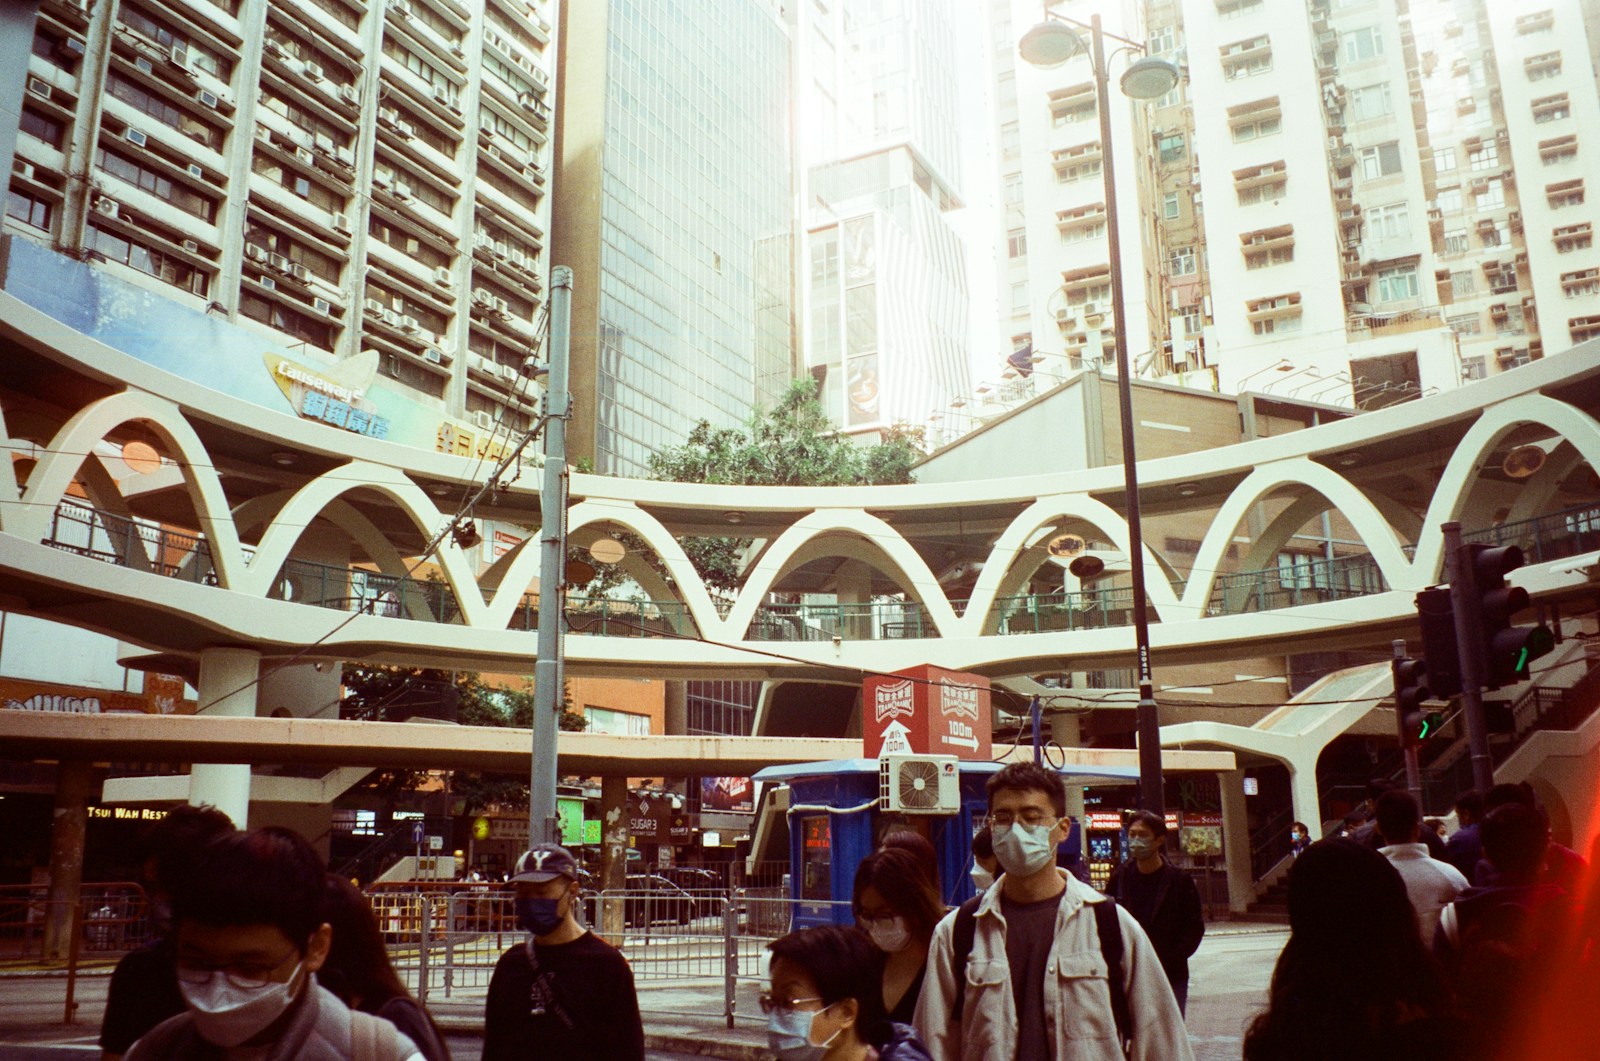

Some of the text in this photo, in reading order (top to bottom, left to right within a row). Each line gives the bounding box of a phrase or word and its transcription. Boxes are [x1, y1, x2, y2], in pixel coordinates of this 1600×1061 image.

[949, 720, 973, 738] 100m
[886, 740, 905, 753] 100m
[87, 806, 111, 818] TSUI
[115, 807, 139, 819] WAH
[630, 818, 658, 831] SUGAR 3
